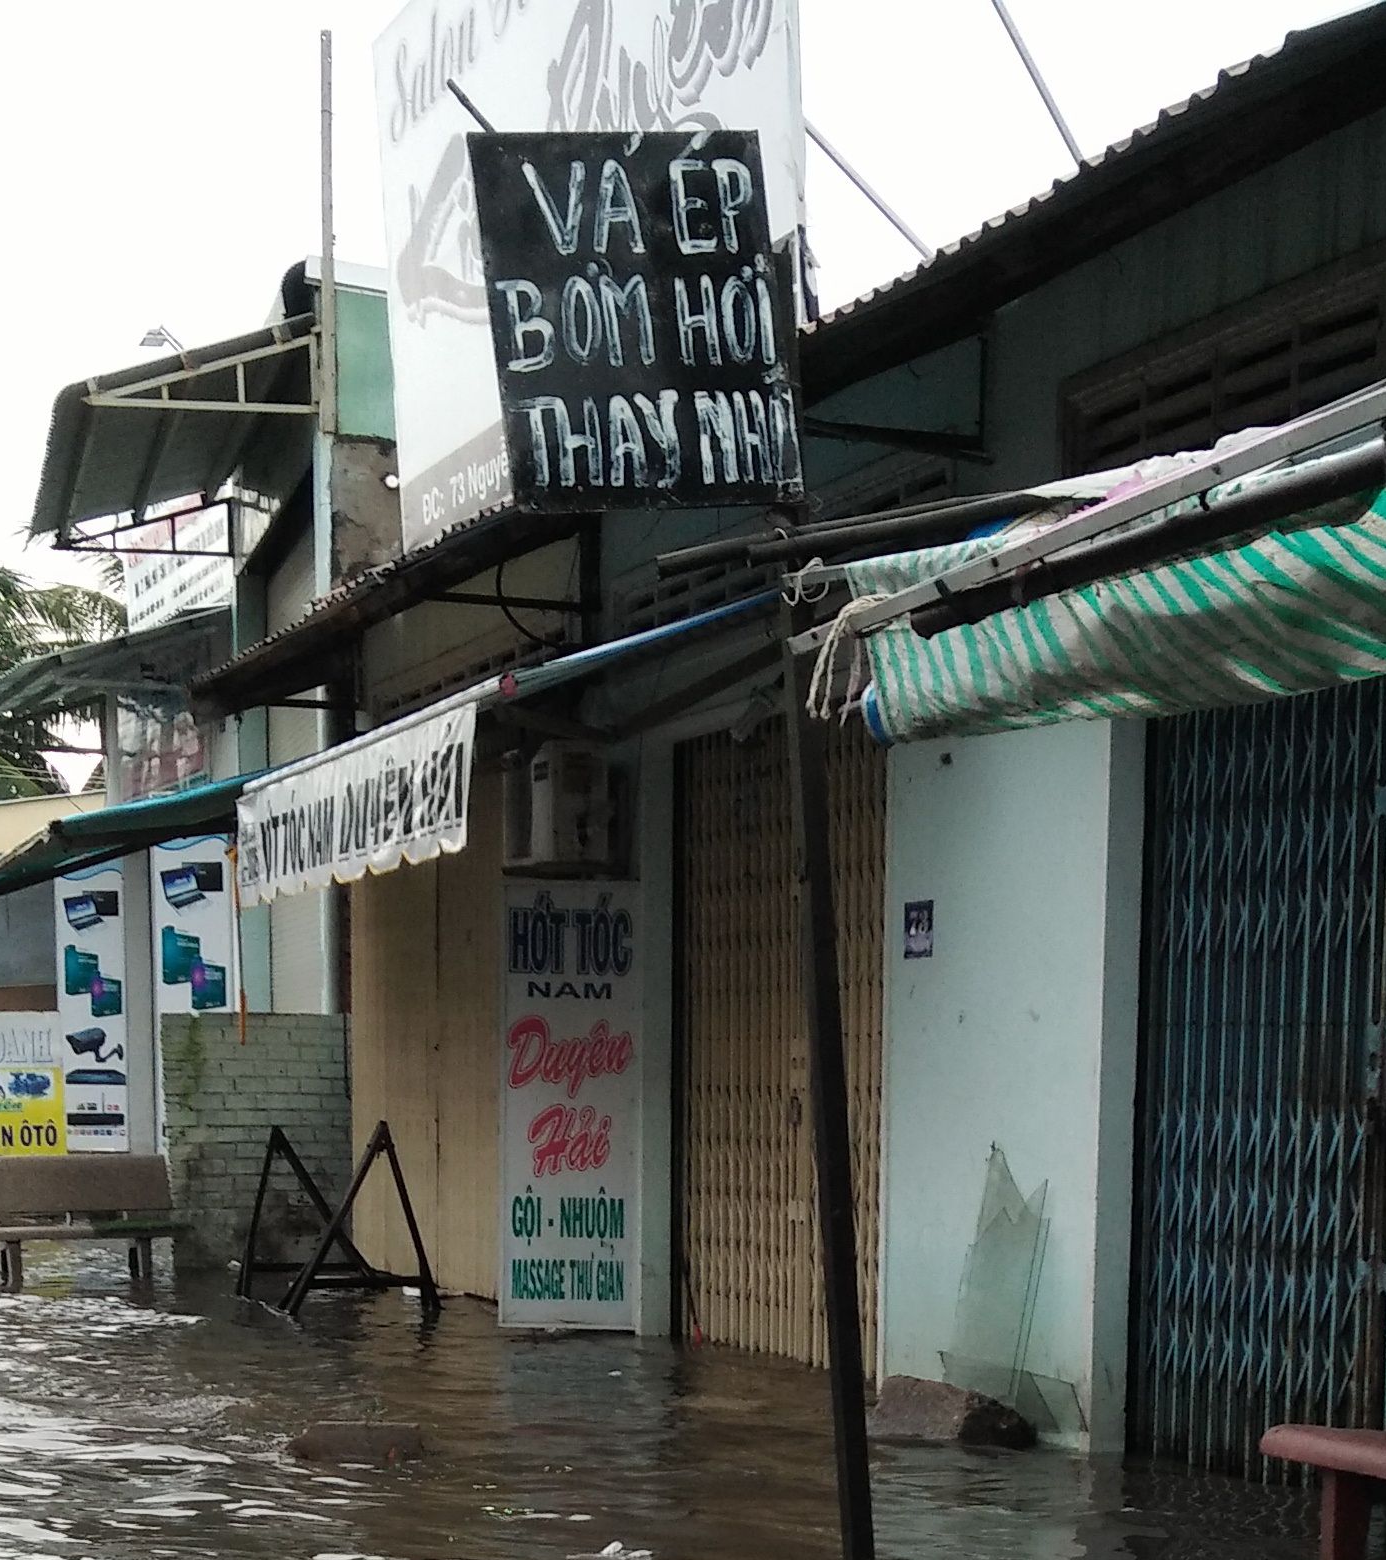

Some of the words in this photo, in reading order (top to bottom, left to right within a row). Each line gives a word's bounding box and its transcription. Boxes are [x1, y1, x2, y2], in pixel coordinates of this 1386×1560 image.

[522, 135, 645, 256] VÁ
[669, 131, 753, 256] ÉP
[509, 389, 679, 488] THAY
[422, 486, 445, 525] ĐC:
[450, 472, 465, 507] 73
[509, 891, 570, 974] HỚT
[572, 892, 633, 976] TÓC
[528, 981, 612, 1000] NAM
[508, 1015, 633, 1098] Duyên
[20, 1119, 57, 1148] ÔTÔ
[528, 1103, 612, 1177] Hải
[512, 1184, 541, 1247] GỘI
[560, 1186, 624, 1248] NHUỘM
[512, 1259, 565, 1300] MASSAGE
